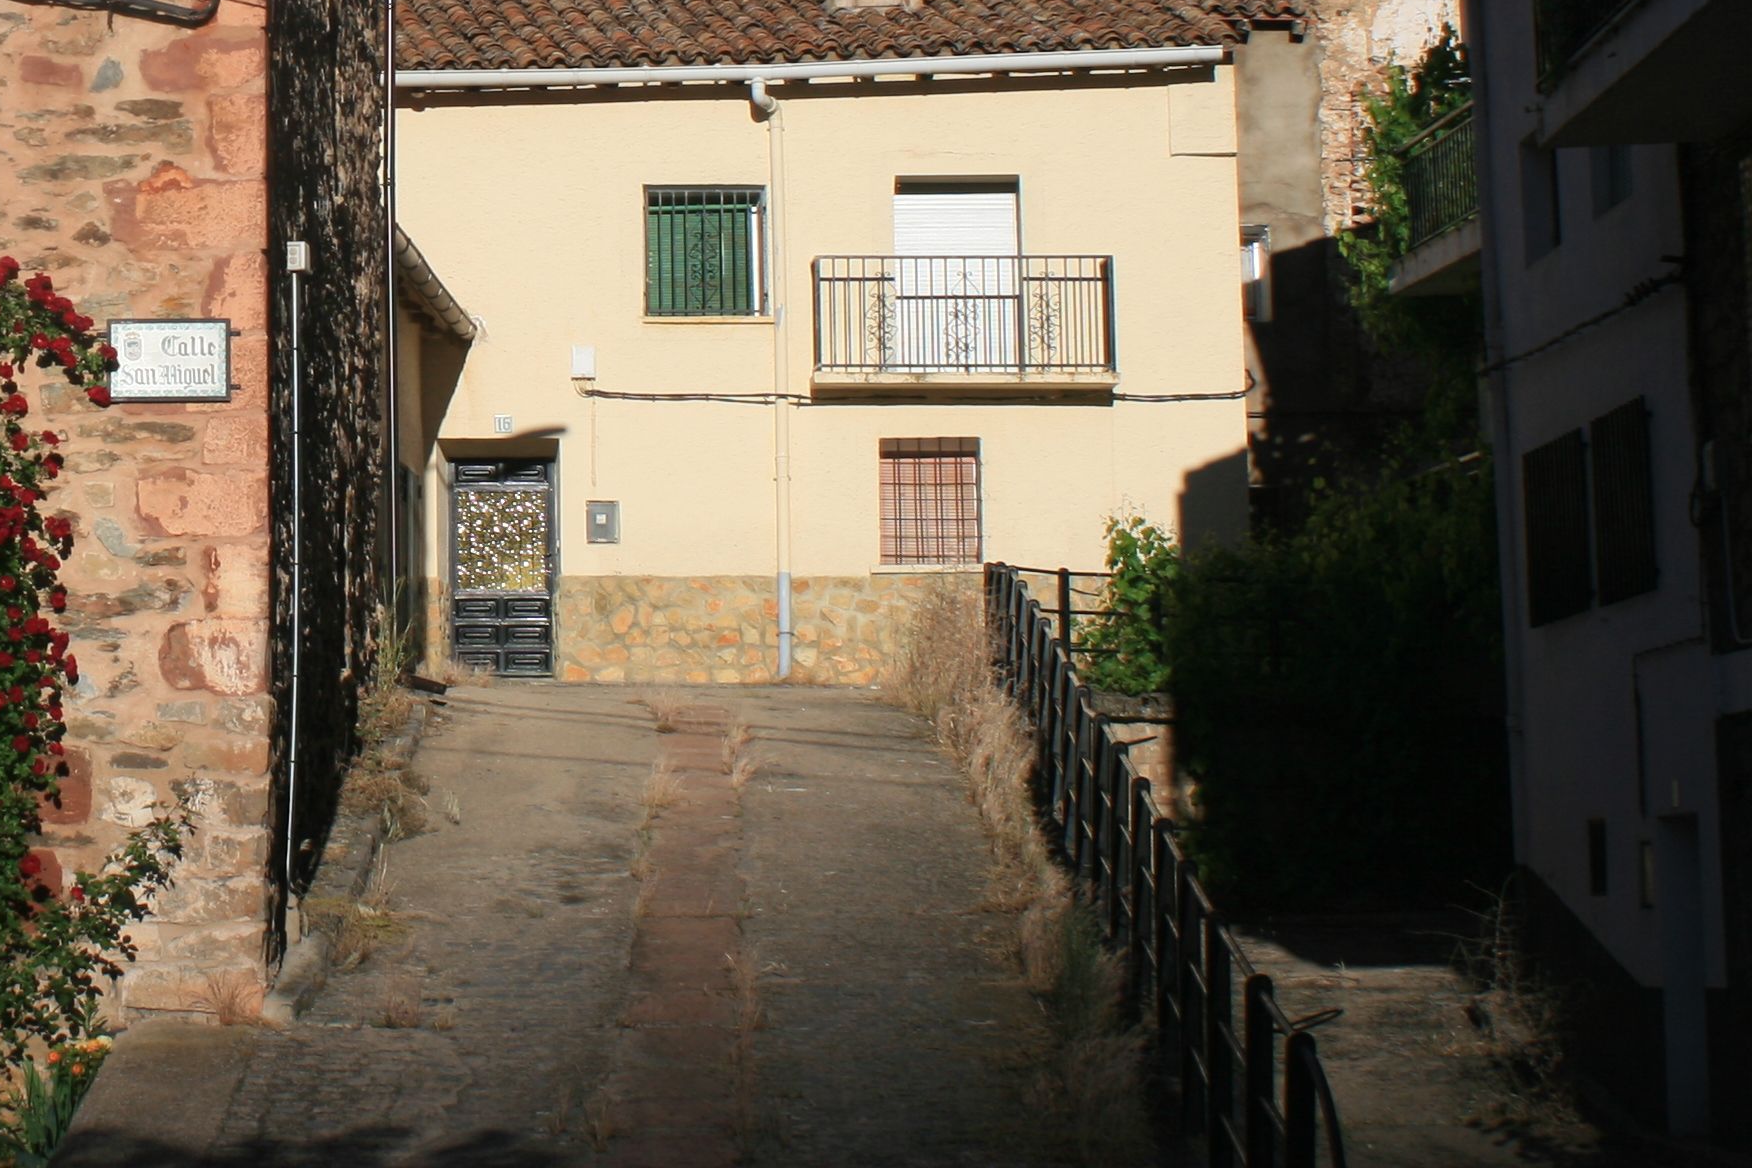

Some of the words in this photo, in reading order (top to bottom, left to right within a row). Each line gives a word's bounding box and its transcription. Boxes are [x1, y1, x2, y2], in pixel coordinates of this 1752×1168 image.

[161, 335, 216, 357] Calle
[120, 363, 156, 385] San
[158, 363, 217, 389] Miguel
[497, 416, 511, 431] 16
